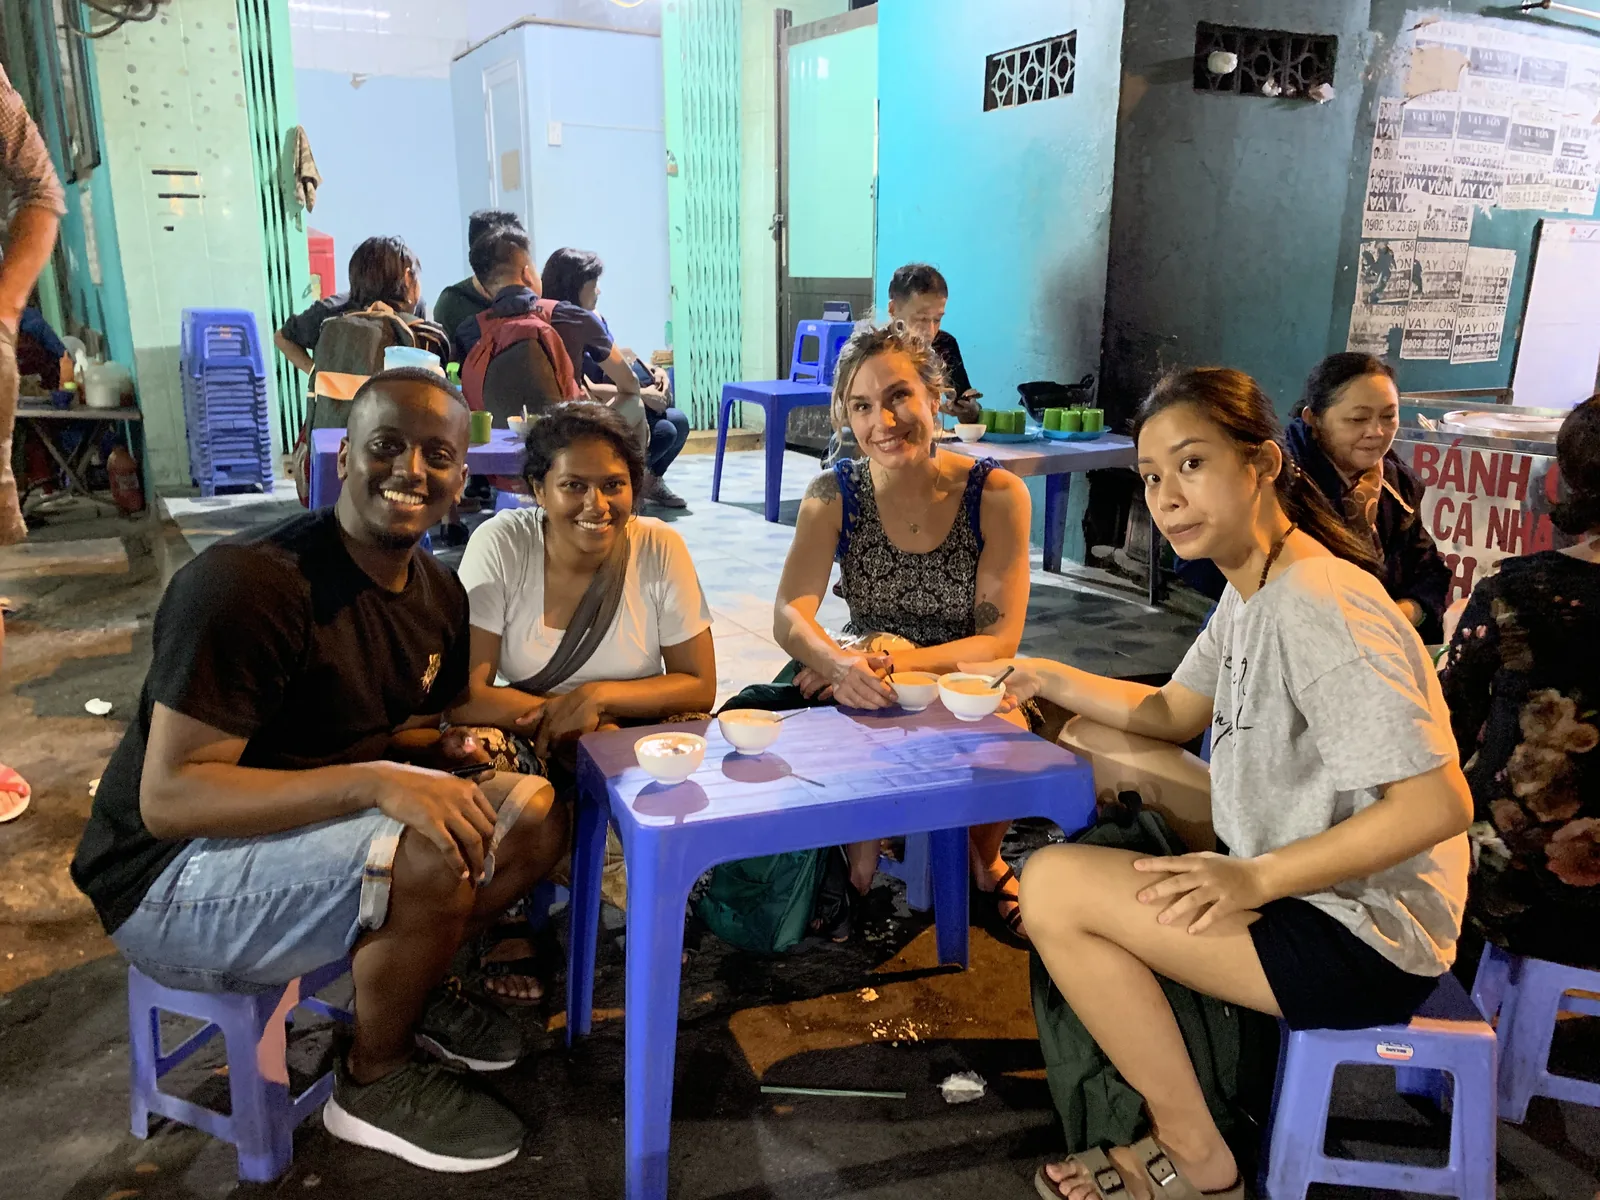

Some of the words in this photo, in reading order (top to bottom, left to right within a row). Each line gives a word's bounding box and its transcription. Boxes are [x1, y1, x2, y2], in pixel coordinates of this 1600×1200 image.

[1408, 319, 1429, 329] VAY
[1458, 323, 1478, 334] VAY
[1413, 438, 1532, 501] BÁNH
[1433, 495, 1478, 547] CÁ
[1485, 505, 1553, 557] NHA
